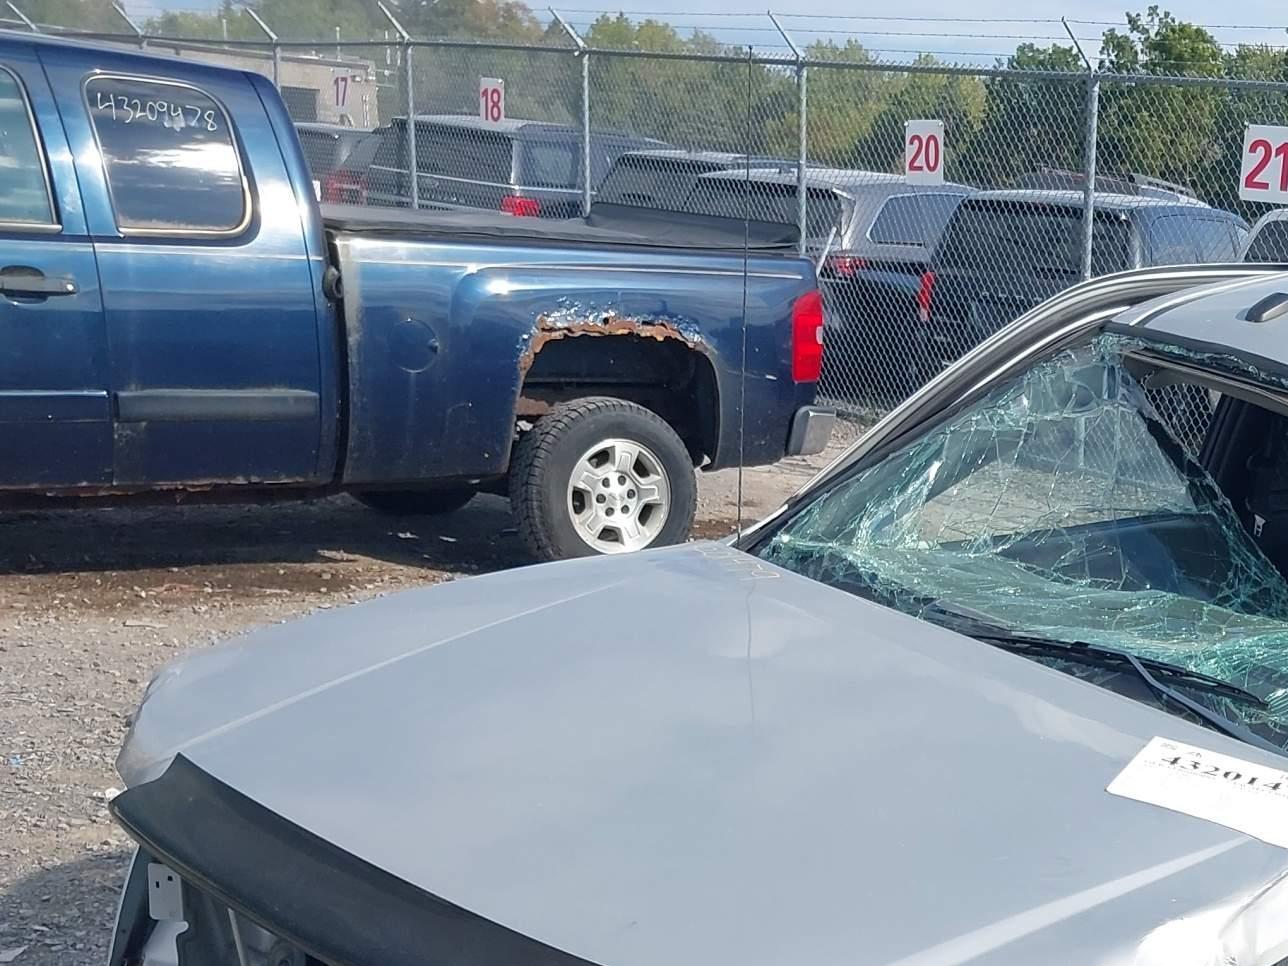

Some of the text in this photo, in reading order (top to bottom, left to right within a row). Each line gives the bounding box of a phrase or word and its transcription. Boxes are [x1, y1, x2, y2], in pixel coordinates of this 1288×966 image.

[334, 77, 348, 106] 17
[481, 88, 501, 122] 18
[97, 92, 217, 132] 43209478
[908, 134, 939, 172] 20
